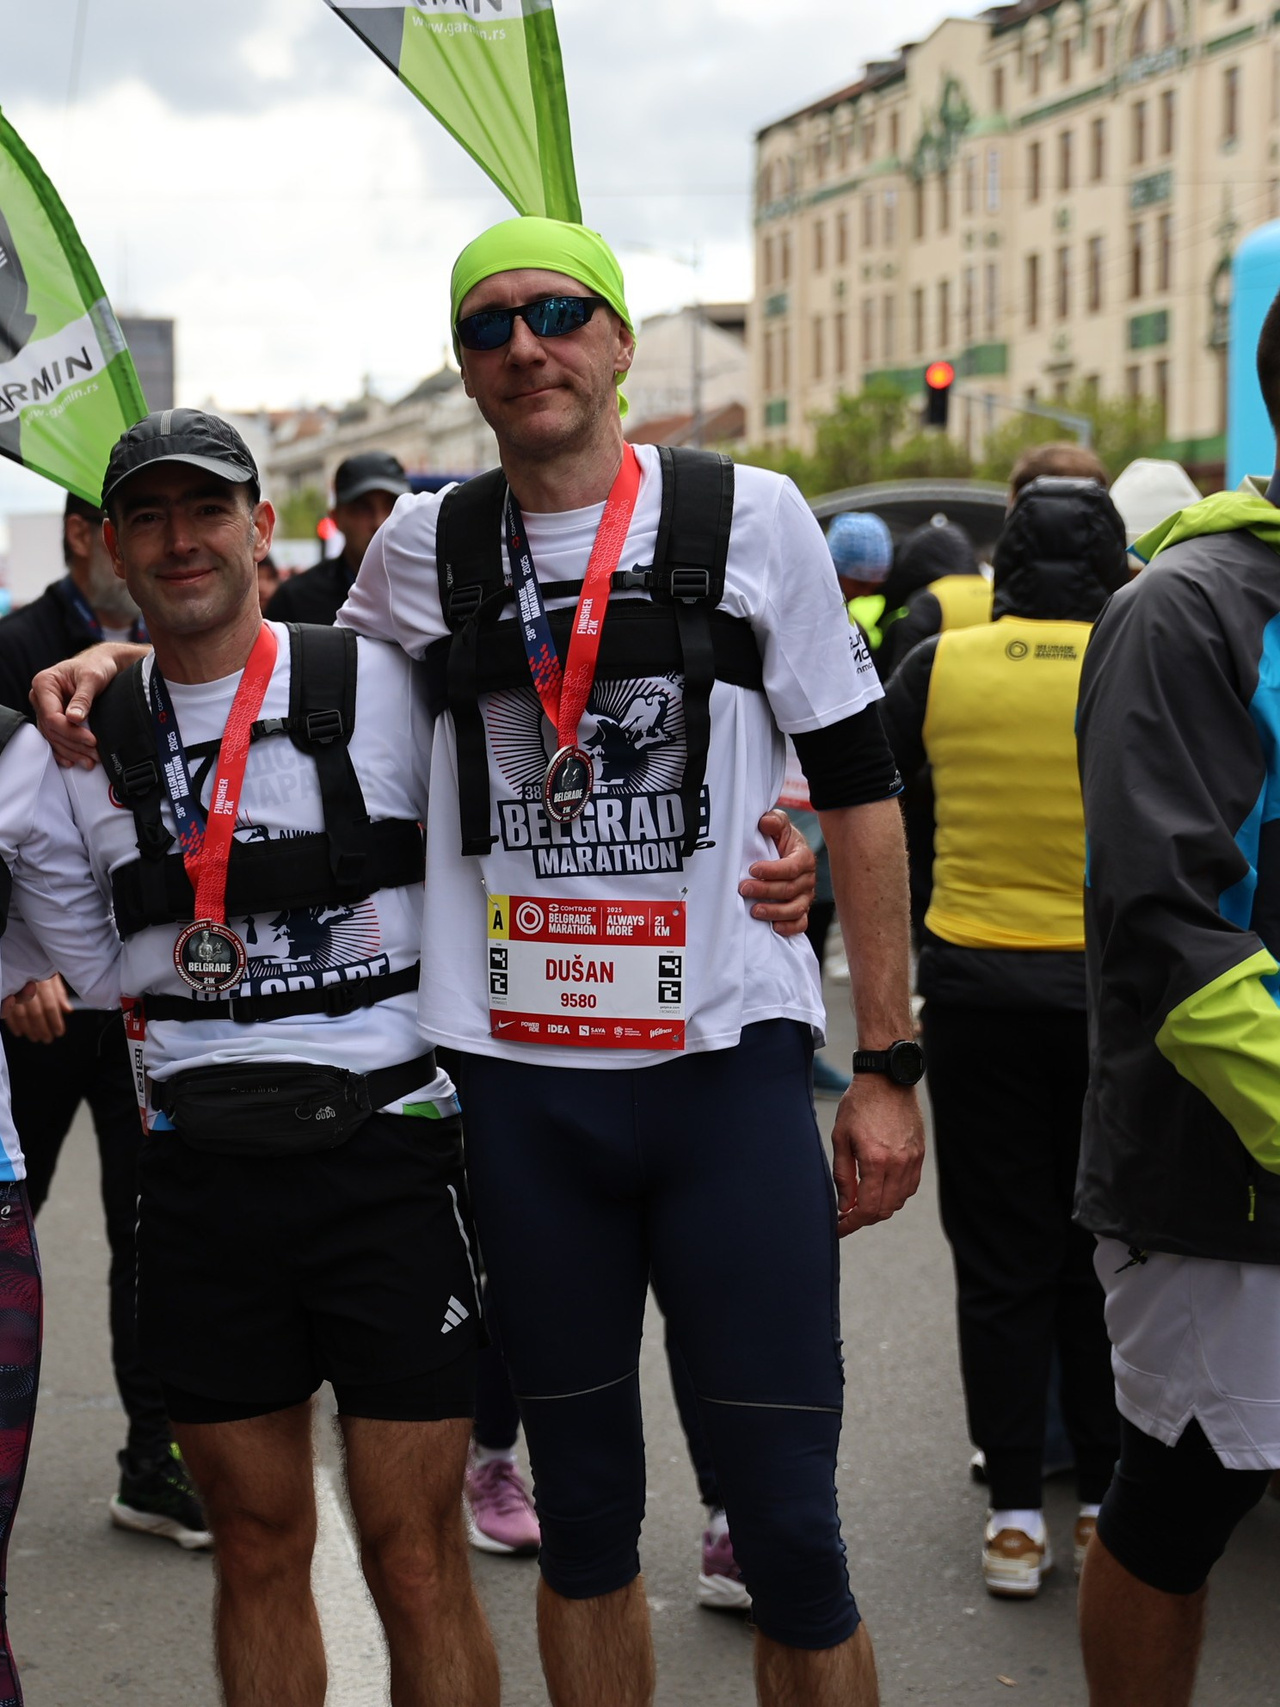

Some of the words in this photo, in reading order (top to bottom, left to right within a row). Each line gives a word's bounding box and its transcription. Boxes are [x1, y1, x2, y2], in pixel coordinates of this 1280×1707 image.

[520, 554, 532, 576] 2025
[518, 586, 531, 623] BELGRADE
[525, 577, 541, 619] MARATHON
[576, 598, 593, 635] FINISHER
[586, 619, 599, 635] 21K
[167, 731, 179, 752] 2025
[164, 761, 181, 801] BELGRADE
[172, 755, 190, 797] MARATHON
[214, 778, 229, 814] FINISHER
[554, 789, 583, 803] BELGRADE
[223, 800, 234, 815] 21K
[502, 791, 707, 848] BELGRAD
[537, 841, 677, 875] MARATHON
[492, 910, 504, 930] A
[548, 913, 591, 925] BELGRADE
[606, 915, 645, 926] ALWAYS
[654, 916, 665, 926] 21
[548, 923, 597, 936] MARATHON
[606, 925, 633, 936] MORE
[654, 926, 670, 937] KM
[188, 962, 231, 973] BELGRADE
[545, 954, 614, 983] DUŠAN
[560, 992, 597, 1009] 9580
